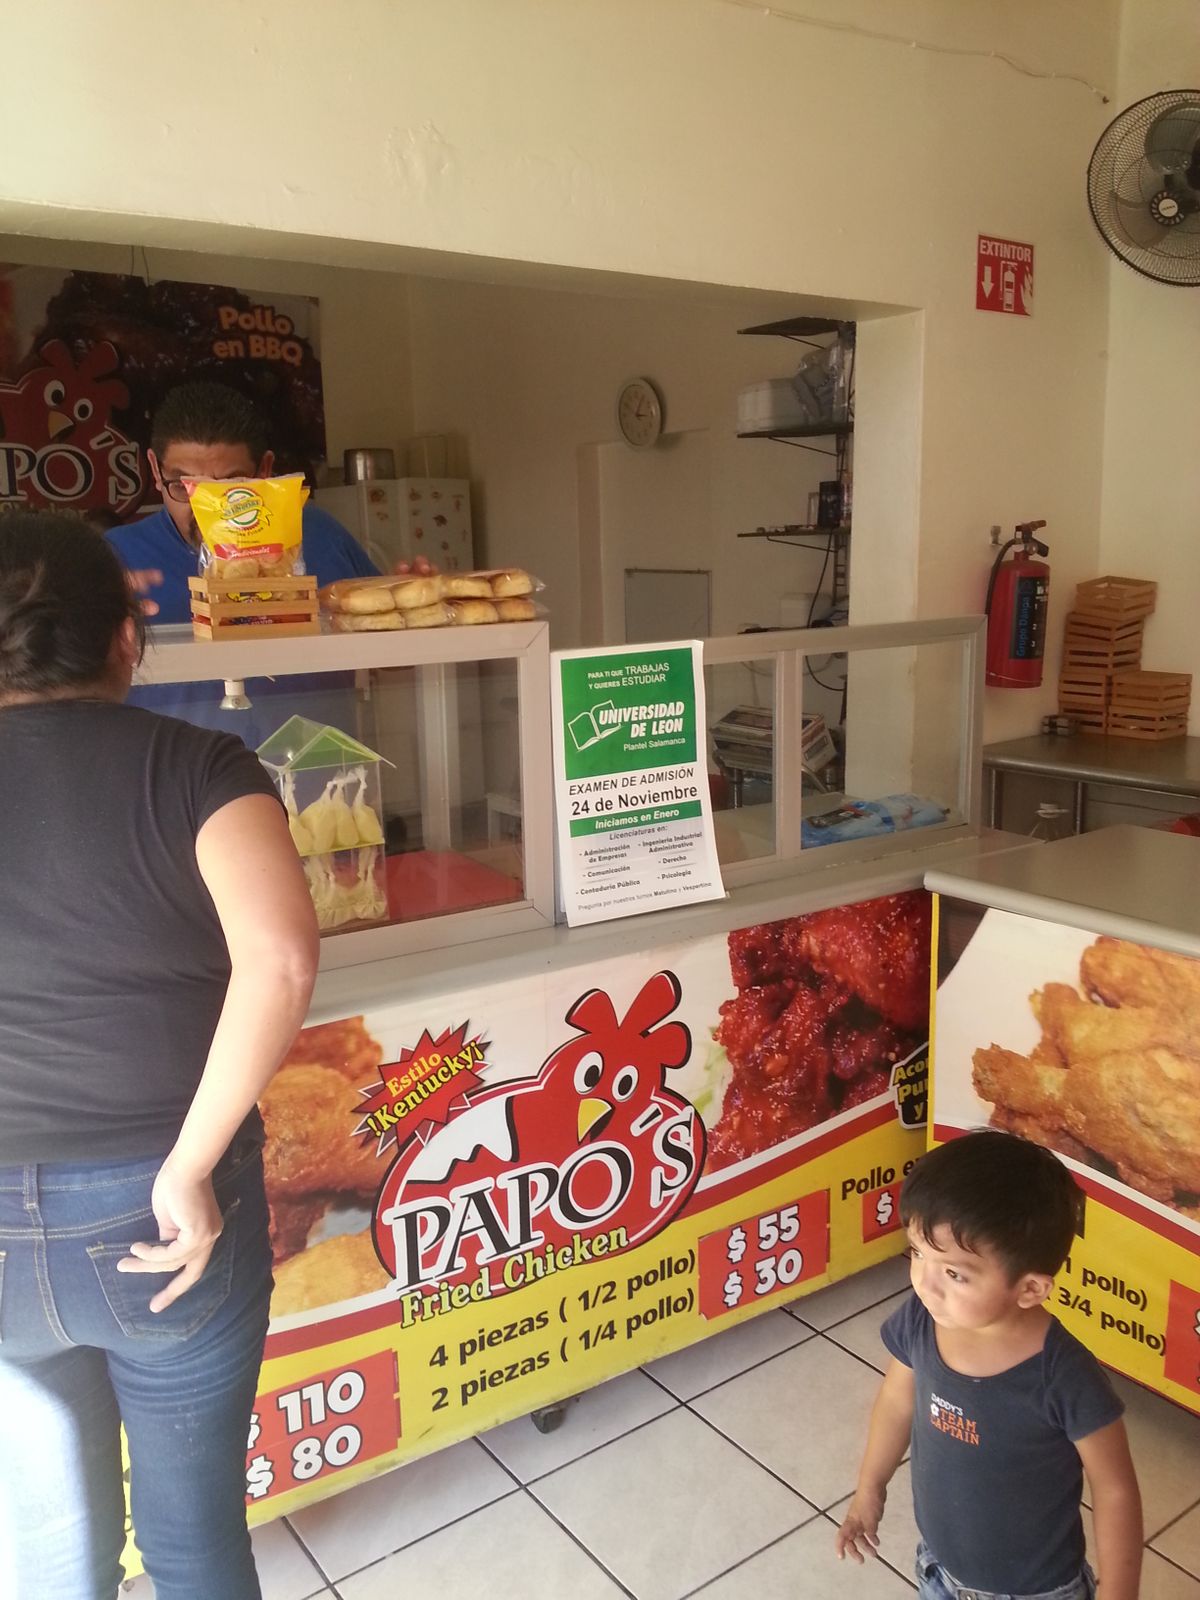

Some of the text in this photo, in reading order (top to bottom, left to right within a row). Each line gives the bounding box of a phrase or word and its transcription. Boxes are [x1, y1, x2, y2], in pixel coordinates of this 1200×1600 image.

[980, 239, 1031, 263] EXTINTOR
[218, 305, 294, 336] Pollo
[213, 334, 304, 368] en BBQ
[0, 430, 142, 505] PO'S
[588, 670, 604, 679] PARA
[611, 669, 623, 677] QUE
[625, 662, 670, 675] TRABAJAS
[594, 681, 620, 690] QUIERES
[622, 673, 666, 686] ESTUDIAR
[599, 701, 685, 725] UNIVERSIDAD
[630, 718, 684, 738] DE LEON
[624, 738, 686, 752] Plantel Salamanca
[569, 766, 694, 796] EXAMEN DE ADMISIÓN
[572, 786, 698, 816] 24 de Noviembre
[595, 809, 680, 830] Iniciamos en Enero
[609, 825, 668, 841] Licenciaturas en:
[584, 843, 631, 857] Administración
[674, 831, 703, 842] Industrial
[587, 865, 631, 878] Comunicación
[598, 852, 628, 863] Empresas
[662, 855, 687, 865] Derecho
[603, 899, 613, 908] por
[613, 896, 636, 905] nuestros
[636, 892, 653, 900] turnos
[653, 888, 677, 896] Matutino
[683, 881, 712, 892] Vespertino
[386, 1052, 442, 1098] Estilo
[893, 1058, 929, 1087] Aco
[841, 1156, 921, 1202] Pollo e
[382, 1104, 696, 1293] PAPO'S
[875, 1190, 894, 1228] $
[727, 1203, 801, 1264] $ 55
[399, 1225, 630, 1330] Fried Chicken
[723, 1247, 804, 1309] $ 30
[1082, 1267, 1148, 1312] pollo)
[429, 1344, 450, 1371] 4
[459, 1309, 550, 1365] piezas
[577, 1279, 618, 1312] 1/2
[626, 1248, 696, 1301] pollo)
[1058, 1286, 1093, 1318] 3/4
[1100, 1311, 1167, 1357] pollo)
[431, 1387, 450, 1413] 2
[461, 1349, 551, 1407] piezas
[578, 1319, 618, 1353] 1/4
[626, 1287, 695, 1340] pollo)
[276, 1370, 366, 1435] 110
[929, 1414, 981, 1446] CAPTAIN
[939, 1408, 977, 1434] TEAM
[246, 1453, 275, 1499] $
[291, 1423, 363, 1482] 80
